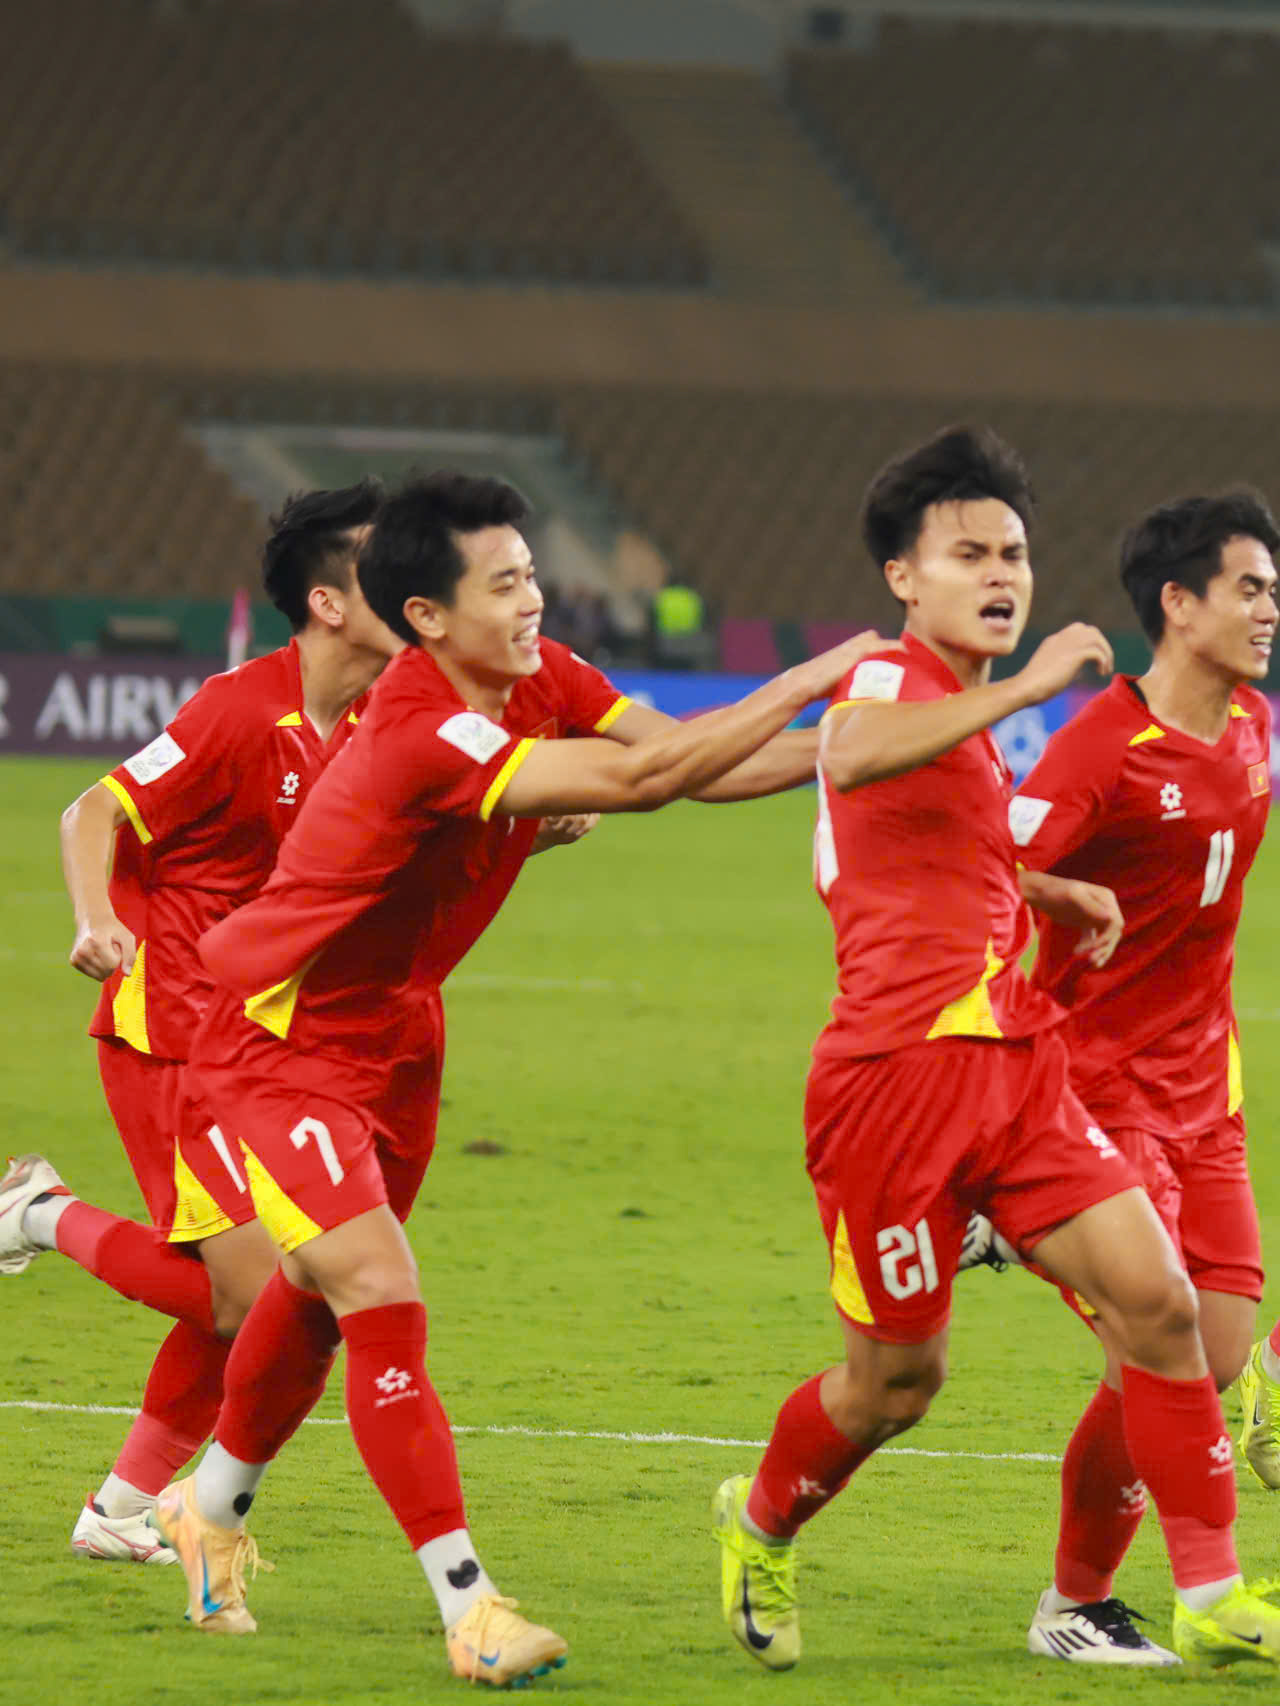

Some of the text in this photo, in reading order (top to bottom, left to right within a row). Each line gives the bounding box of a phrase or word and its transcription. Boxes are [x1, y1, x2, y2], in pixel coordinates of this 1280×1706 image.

[1199, 828, 1235, 908] 11
[288, 1115, 345, 1187] 7
[876, 1217, 939, 1300] 21
